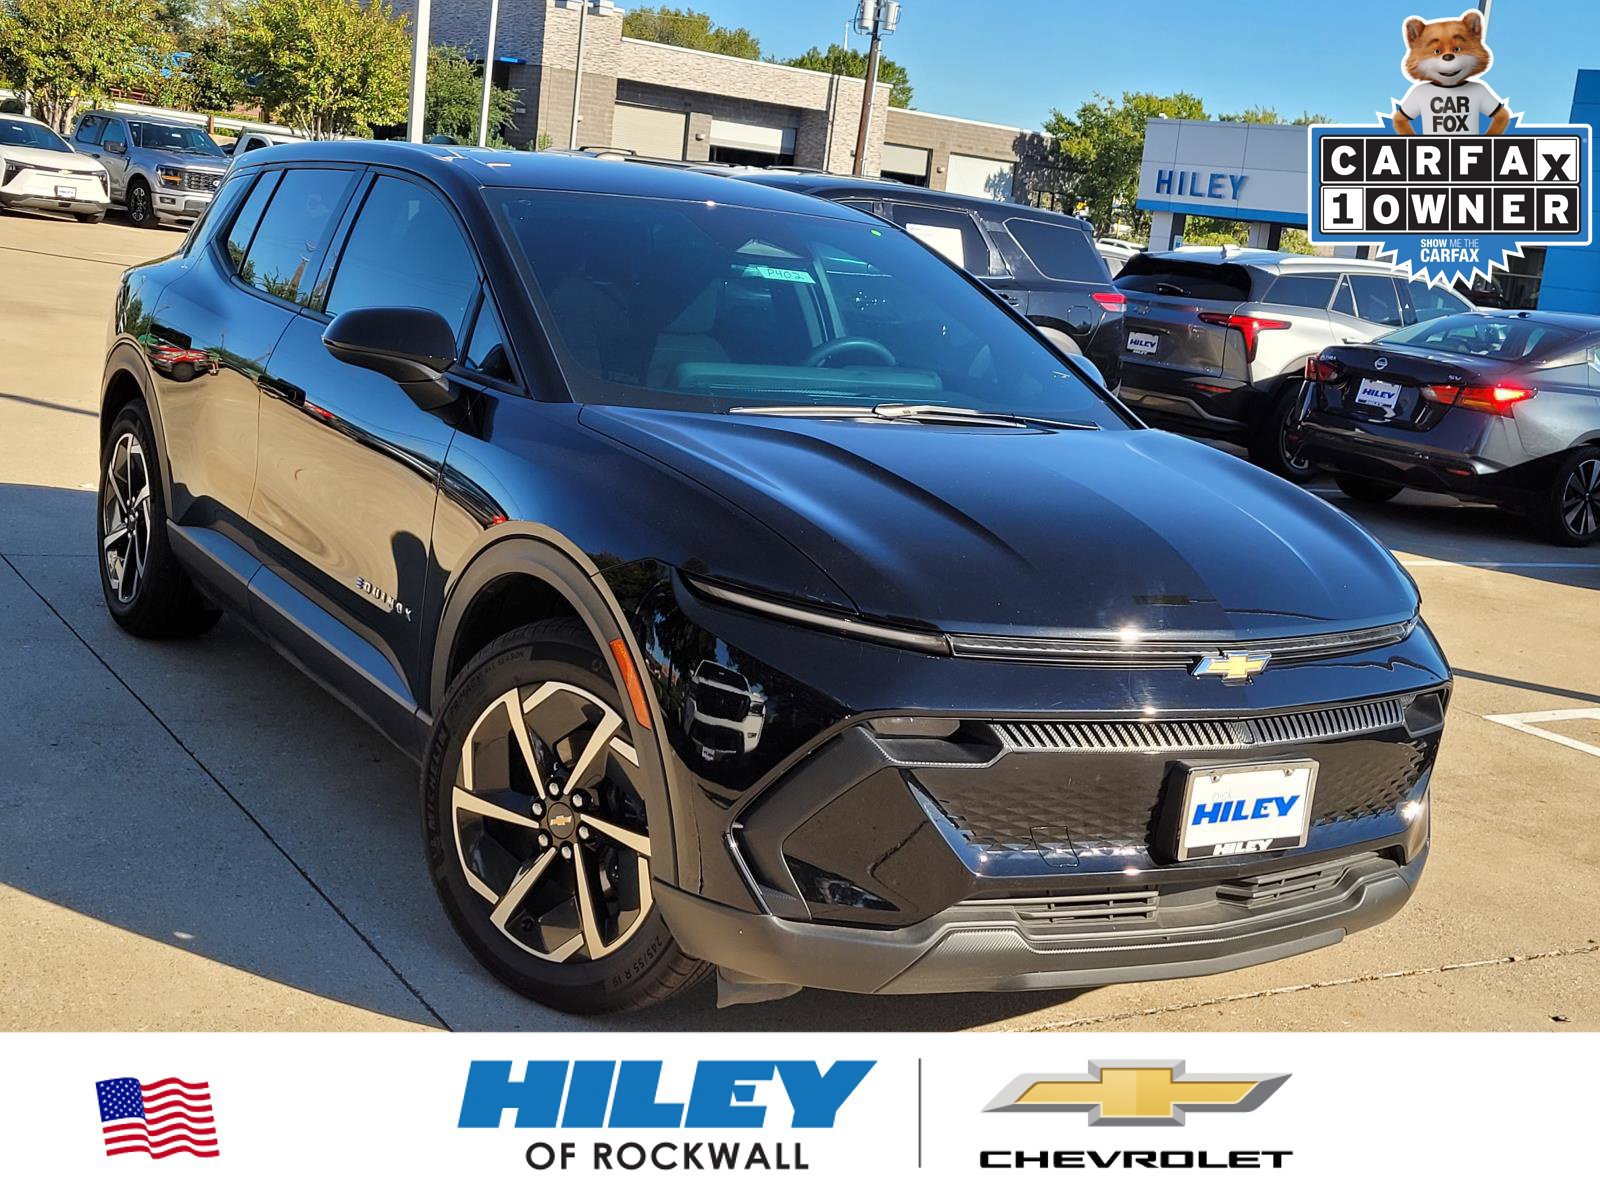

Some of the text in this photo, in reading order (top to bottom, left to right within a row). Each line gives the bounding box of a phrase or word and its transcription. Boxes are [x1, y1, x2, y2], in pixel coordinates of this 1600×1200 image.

[1155, 169, 1249, 200] HILEY
[1129, 338, 1156, 348] HILEY
[1362, 388, 1396, 399] HILEY
[1191, 795, 1300, 826] HILEY
[1212, 838, 1273, 856] HILEY
